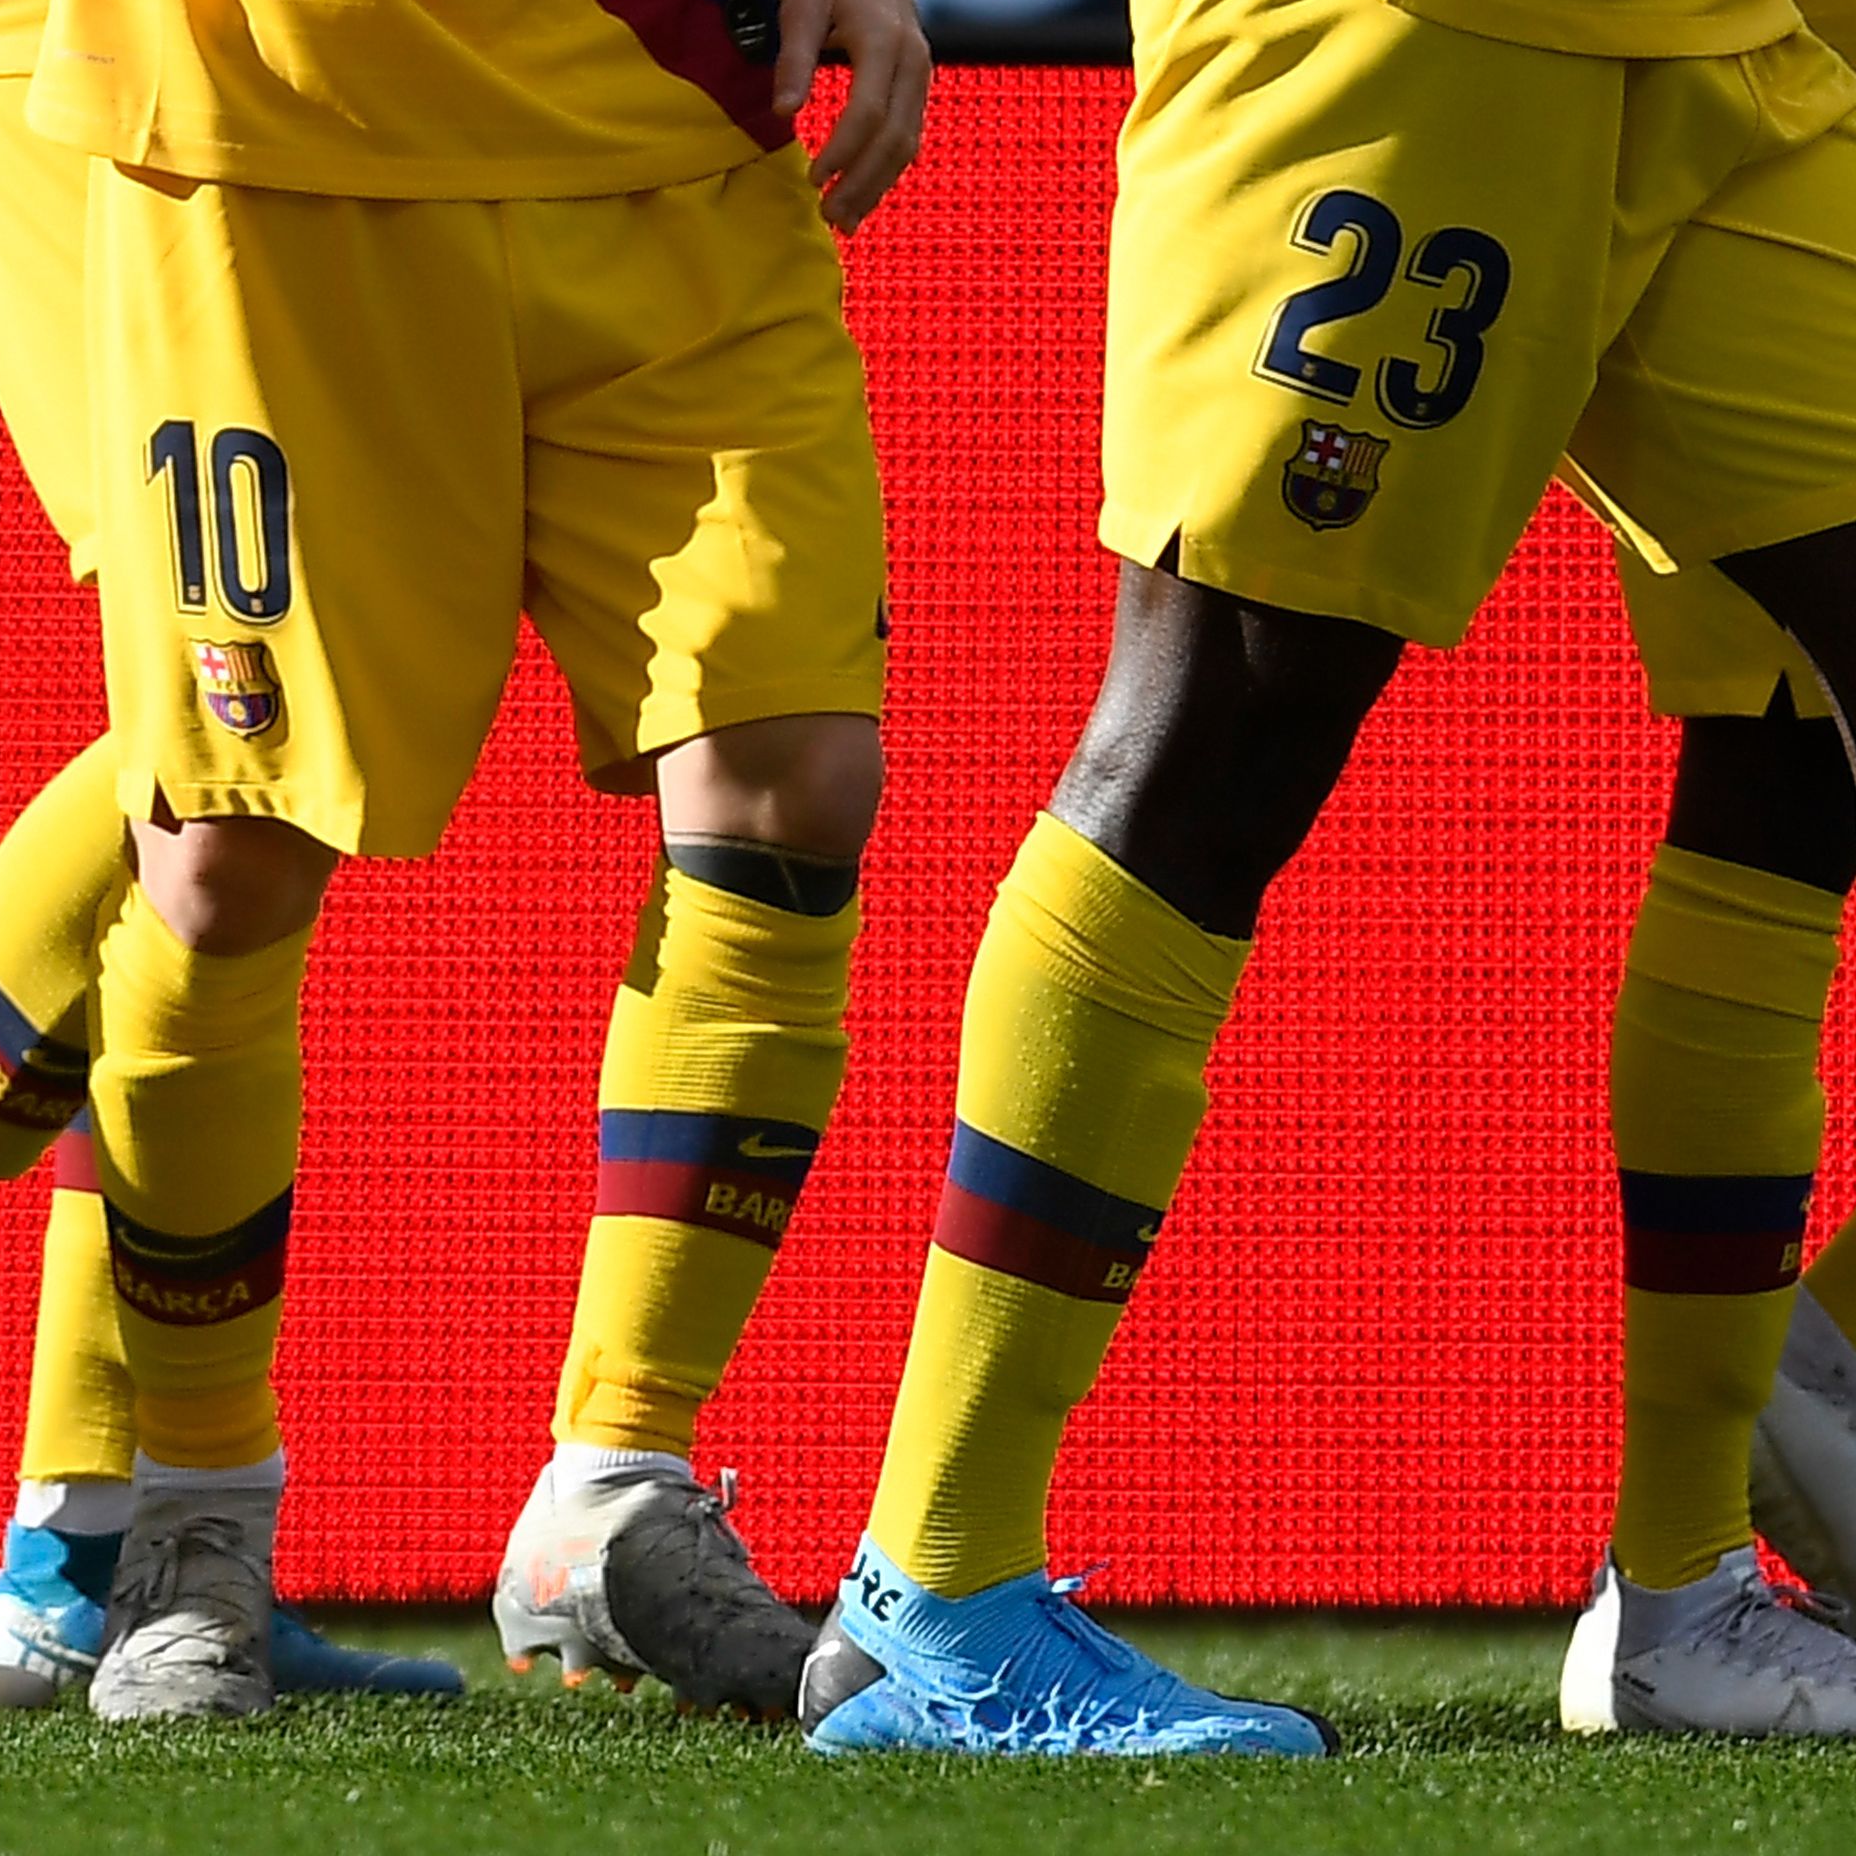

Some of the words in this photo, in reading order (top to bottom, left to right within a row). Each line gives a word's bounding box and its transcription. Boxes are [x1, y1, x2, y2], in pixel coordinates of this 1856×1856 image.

[1251, 189, 1513, 431] 23
[144, 419, 293, 627] 10
[704, 1182, 792, 1231] BAR
